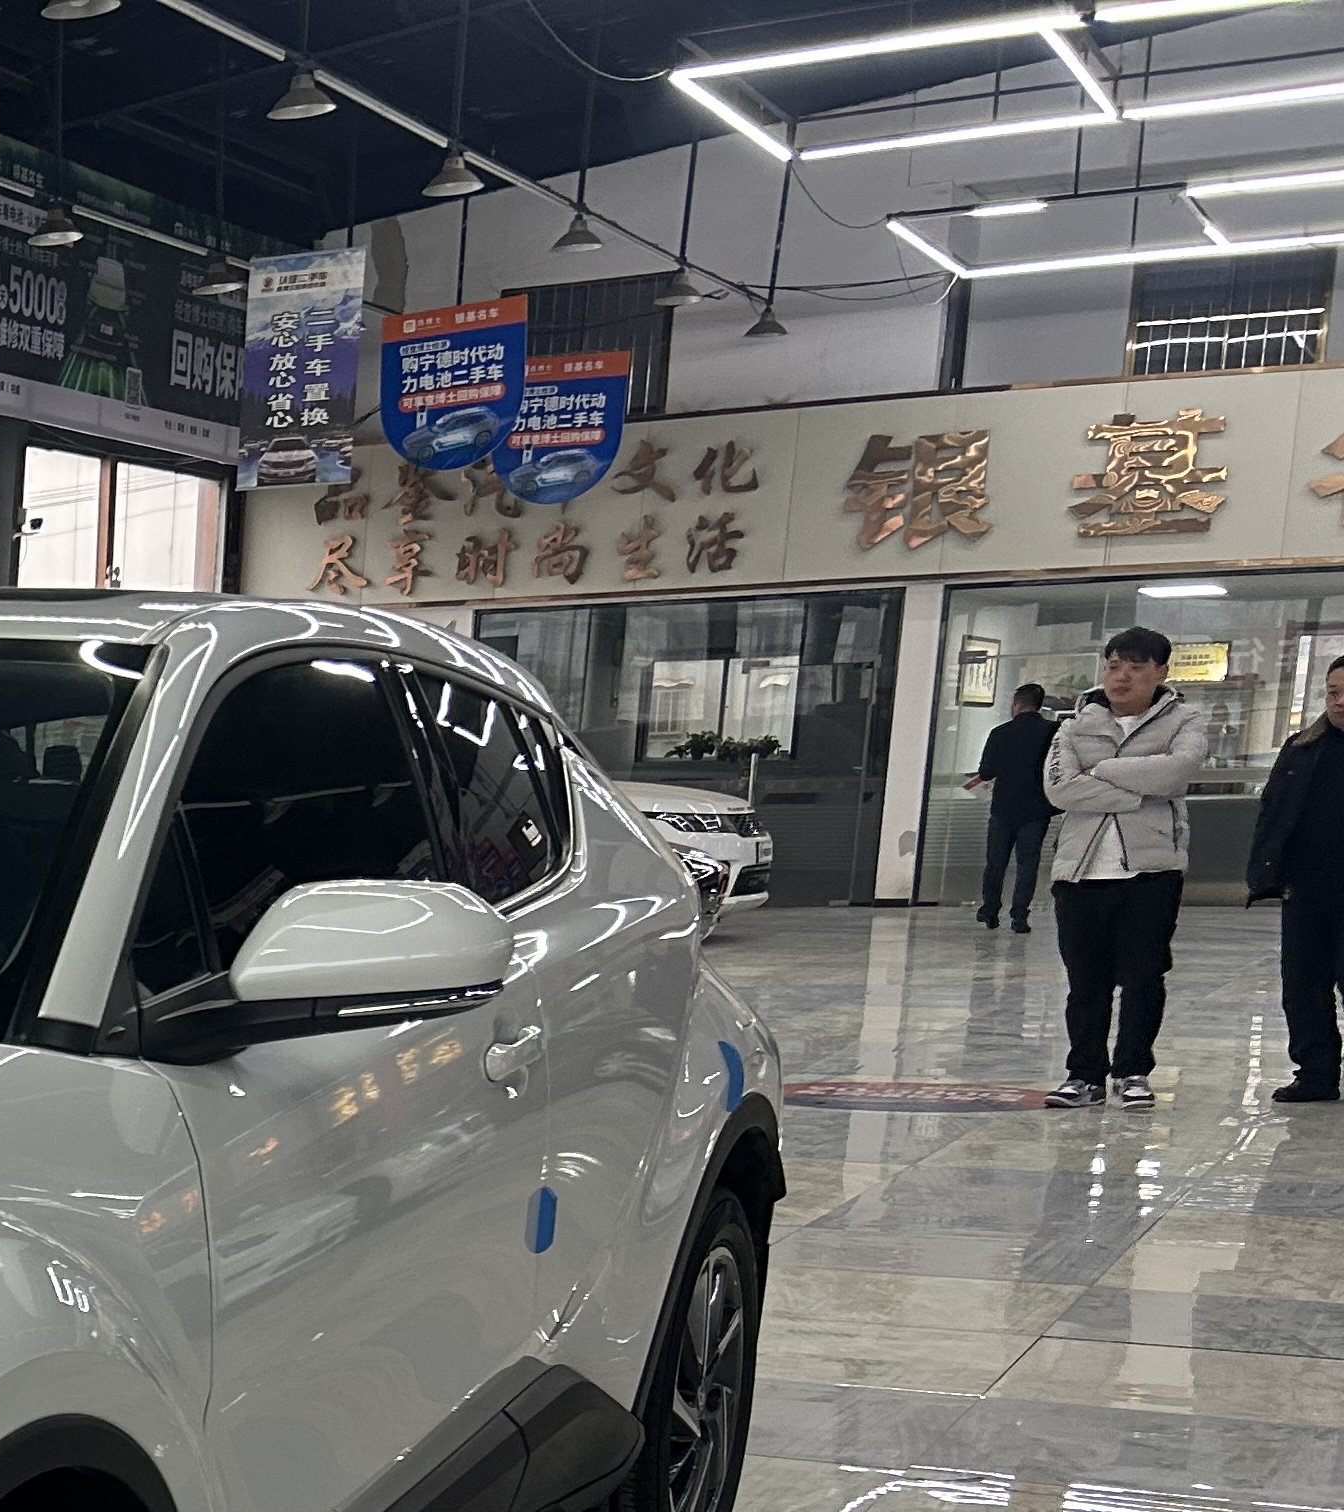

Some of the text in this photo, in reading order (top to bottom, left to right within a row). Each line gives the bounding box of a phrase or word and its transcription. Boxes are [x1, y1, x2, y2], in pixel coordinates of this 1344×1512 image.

[265, 311, 300, 429] 安心放心省心
[300, 309, 335, 427] 二手车置换
[401, 343, 505, 374] 购宁德时代动
[401, 363, 504, 394] 力电池二手车
[511, 410, 606, 432] 力电池二手车
[305, 511, 744, 596] 尽享时尚生活
